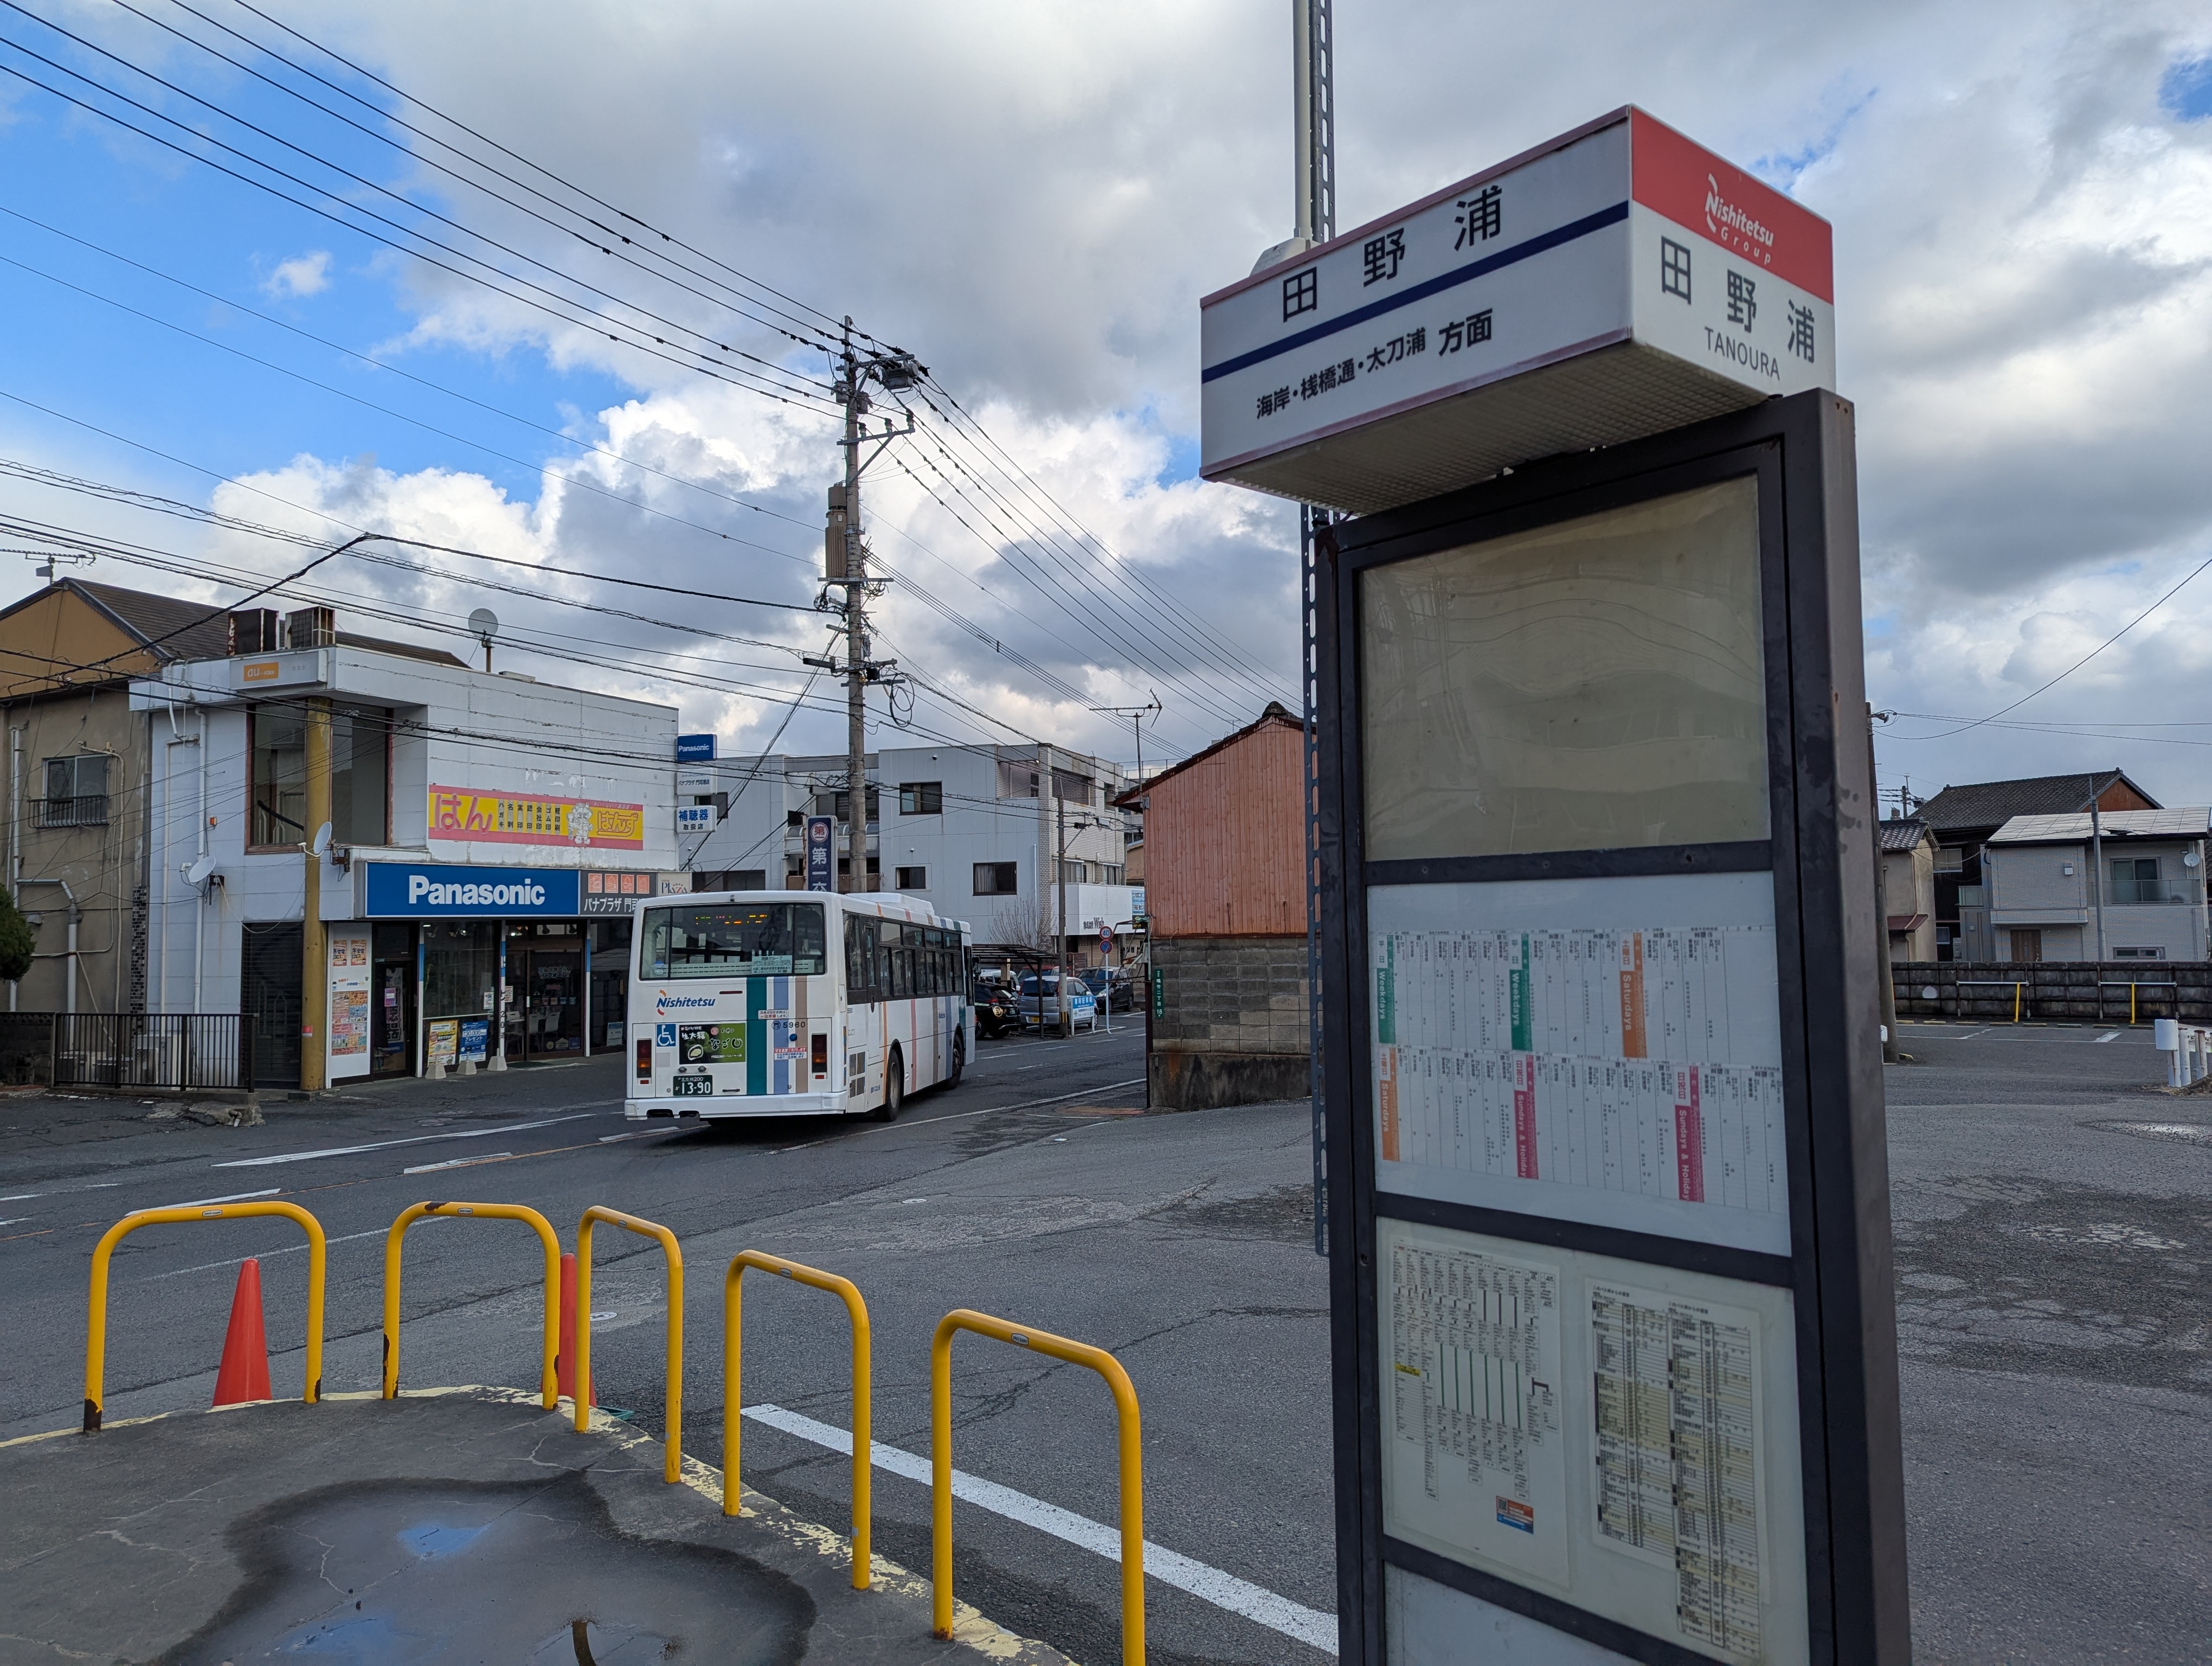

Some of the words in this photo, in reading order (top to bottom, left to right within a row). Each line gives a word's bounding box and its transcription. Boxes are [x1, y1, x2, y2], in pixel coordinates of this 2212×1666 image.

[1705, 191, 1774, 246] Nishitetsu
[1283, 185, 1502, 323] 田野浦
[1721, 227, 1771, 265] Group
[1661, 235, 1815, 363] 田野浦
[1257, 328, 1426, 419] 海岸・桟橋通・太刀浦
[1439, 309, 1493, 356] 方面
[1705, 326, 1780, 380] TANOURA
[247, 668, 260, 677] au
[678, 744, 709, 753] Panasonic
[435, 793, 492, 835] はん
[507, 804, 513, 828] 名刺
[679, 809, 709, 822] 補聴器
[408, 875, 545, 906] Panasonic
[584, 897, 622, 912] パナプラザ
[624, 898, 640, 912] 門司
[1379, 940, 1385, 963] 平日
[1512, 940, 1518, 964] 平日
[656, 997, 716, 1008] Nishitetsu
[1512, 973, 1520, 1026] Weekdays
[1623, 975, 1633, 1030] Saturdays
[681, 1031, 705, 1040] 生大福
[681, 1082, 711, 1094] 13-90
[1680, 1110, 1688, 1149] Sundays
[1682, 1165, 1691, 1200] Holiday
